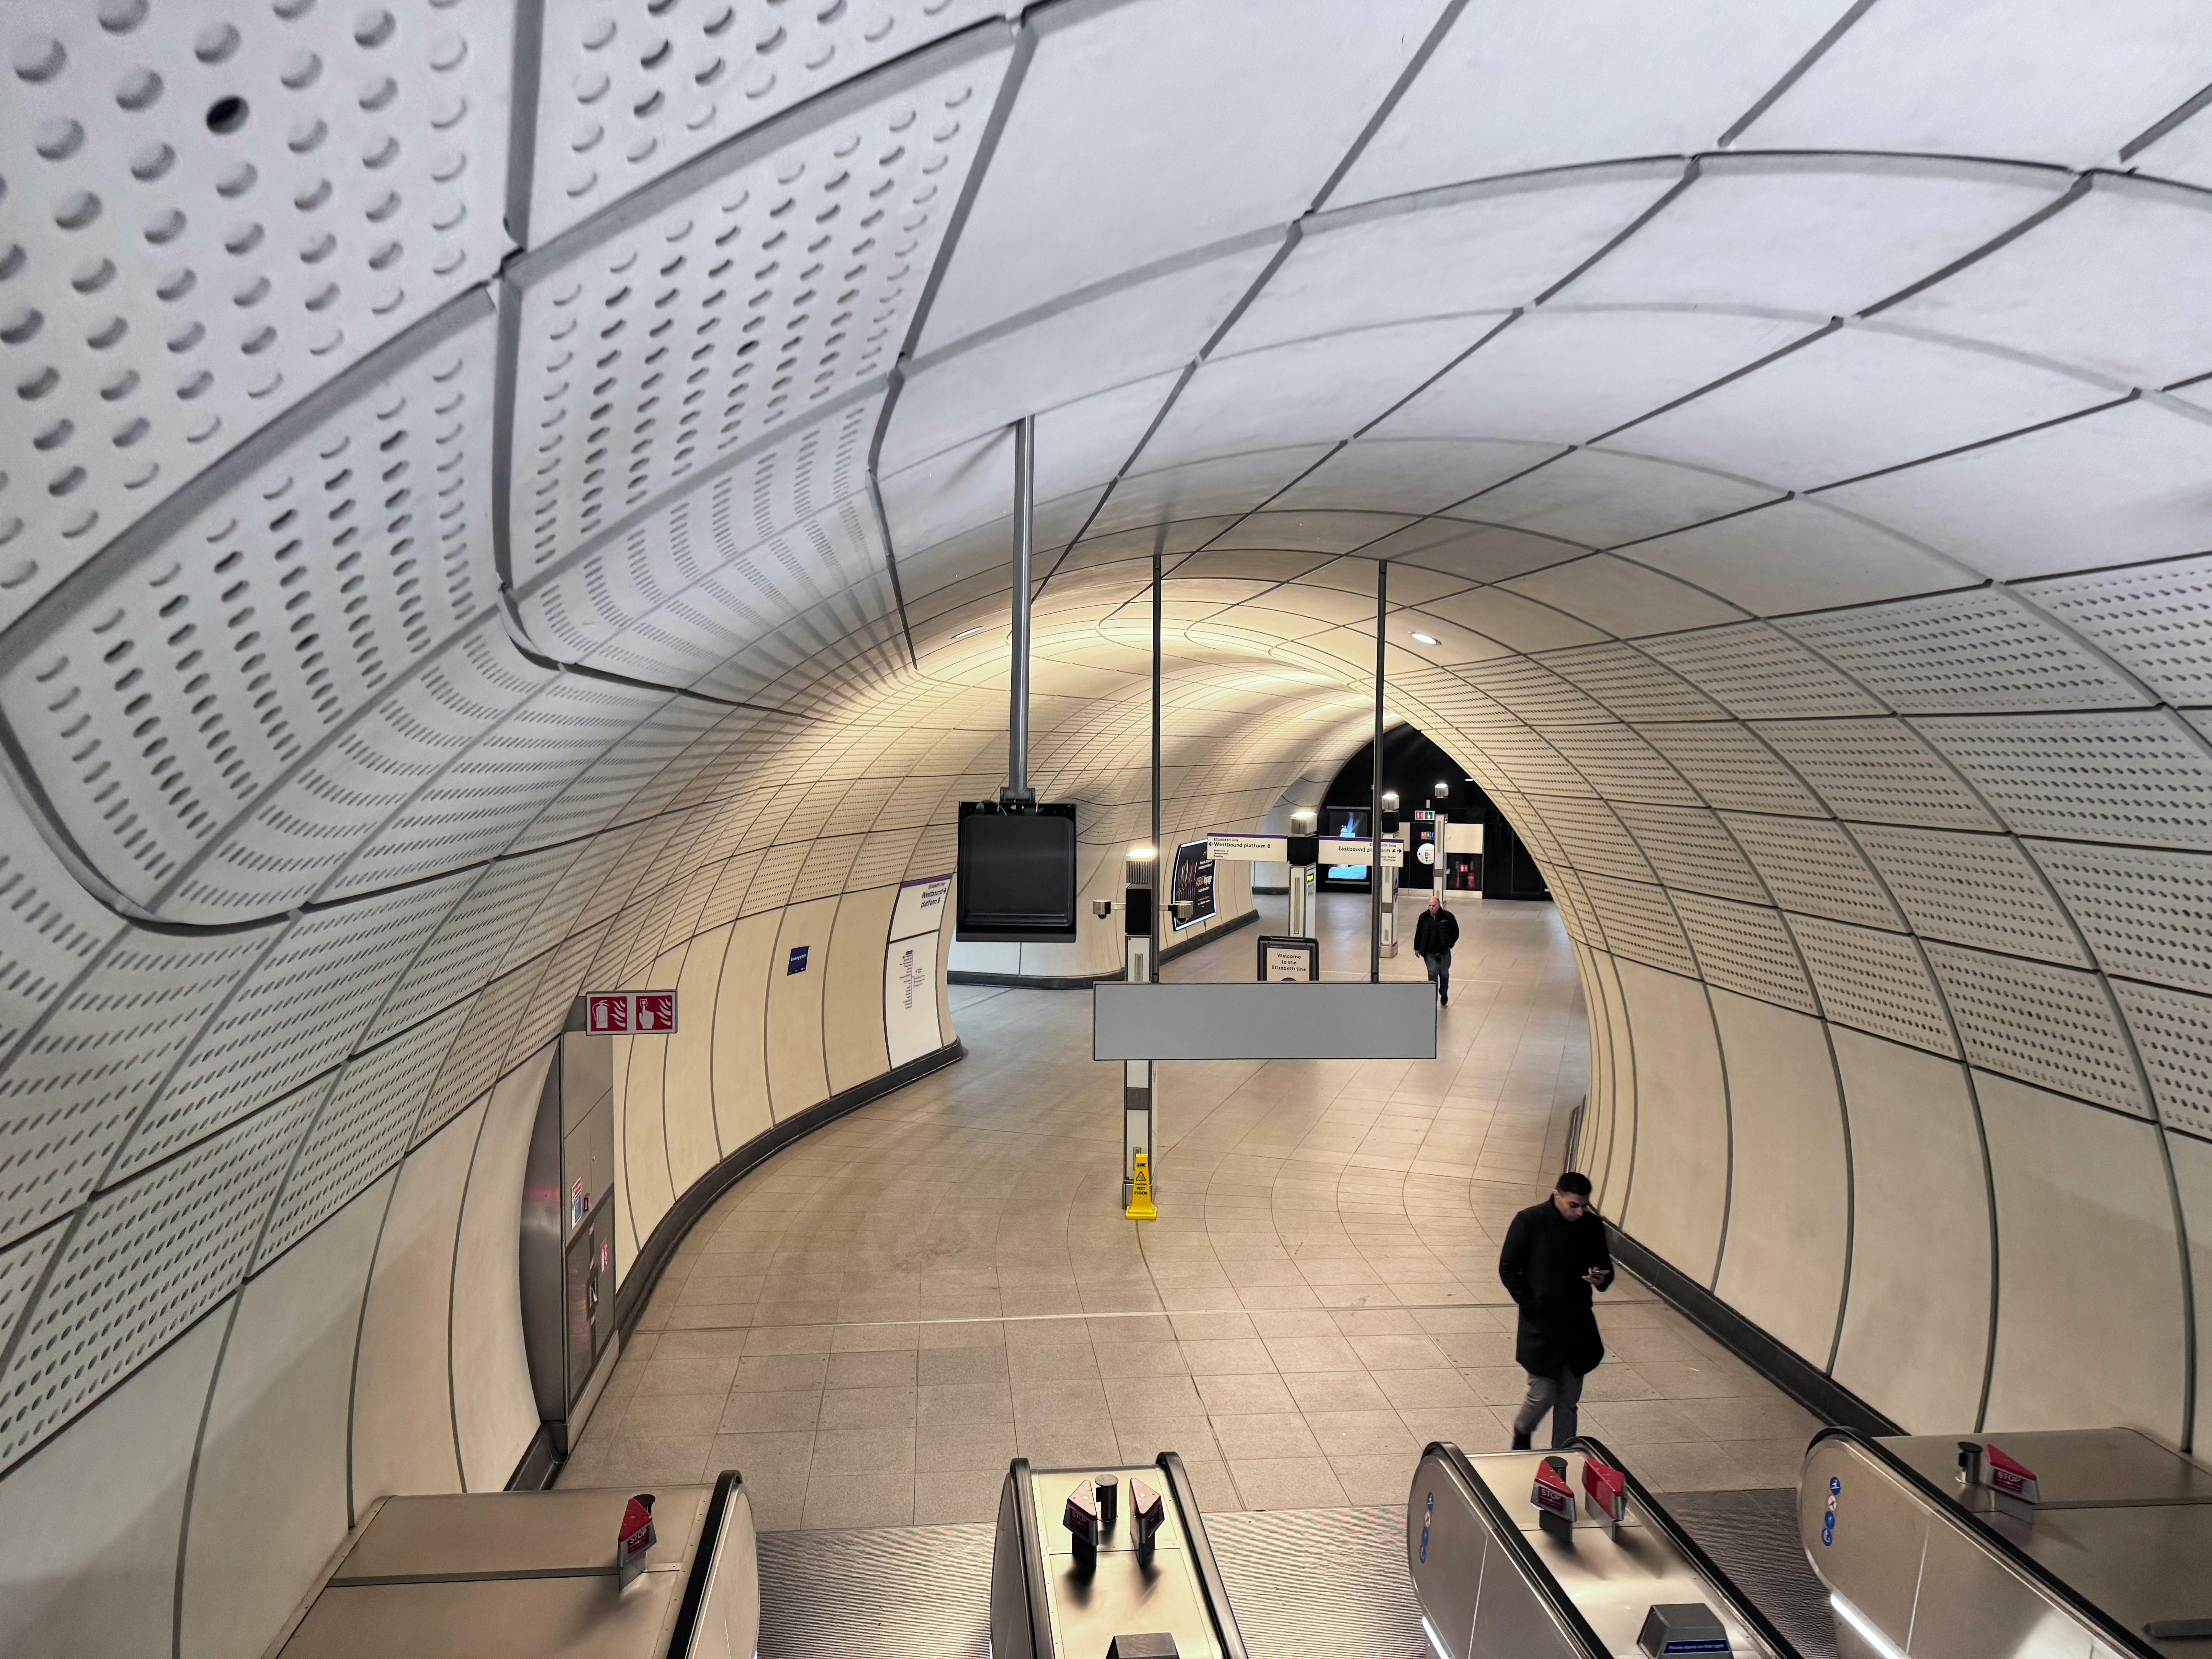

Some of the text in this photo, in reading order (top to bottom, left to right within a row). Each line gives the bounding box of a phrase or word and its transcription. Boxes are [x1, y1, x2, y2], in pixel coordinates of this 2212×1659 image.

[1997, 1471, 2021, 1482] STOP
[1541, 1488, 1561, 1500] STOP
[1072, 1510, 1088, 1523] STOP
[630, 1528, 647, 1543] STOP
